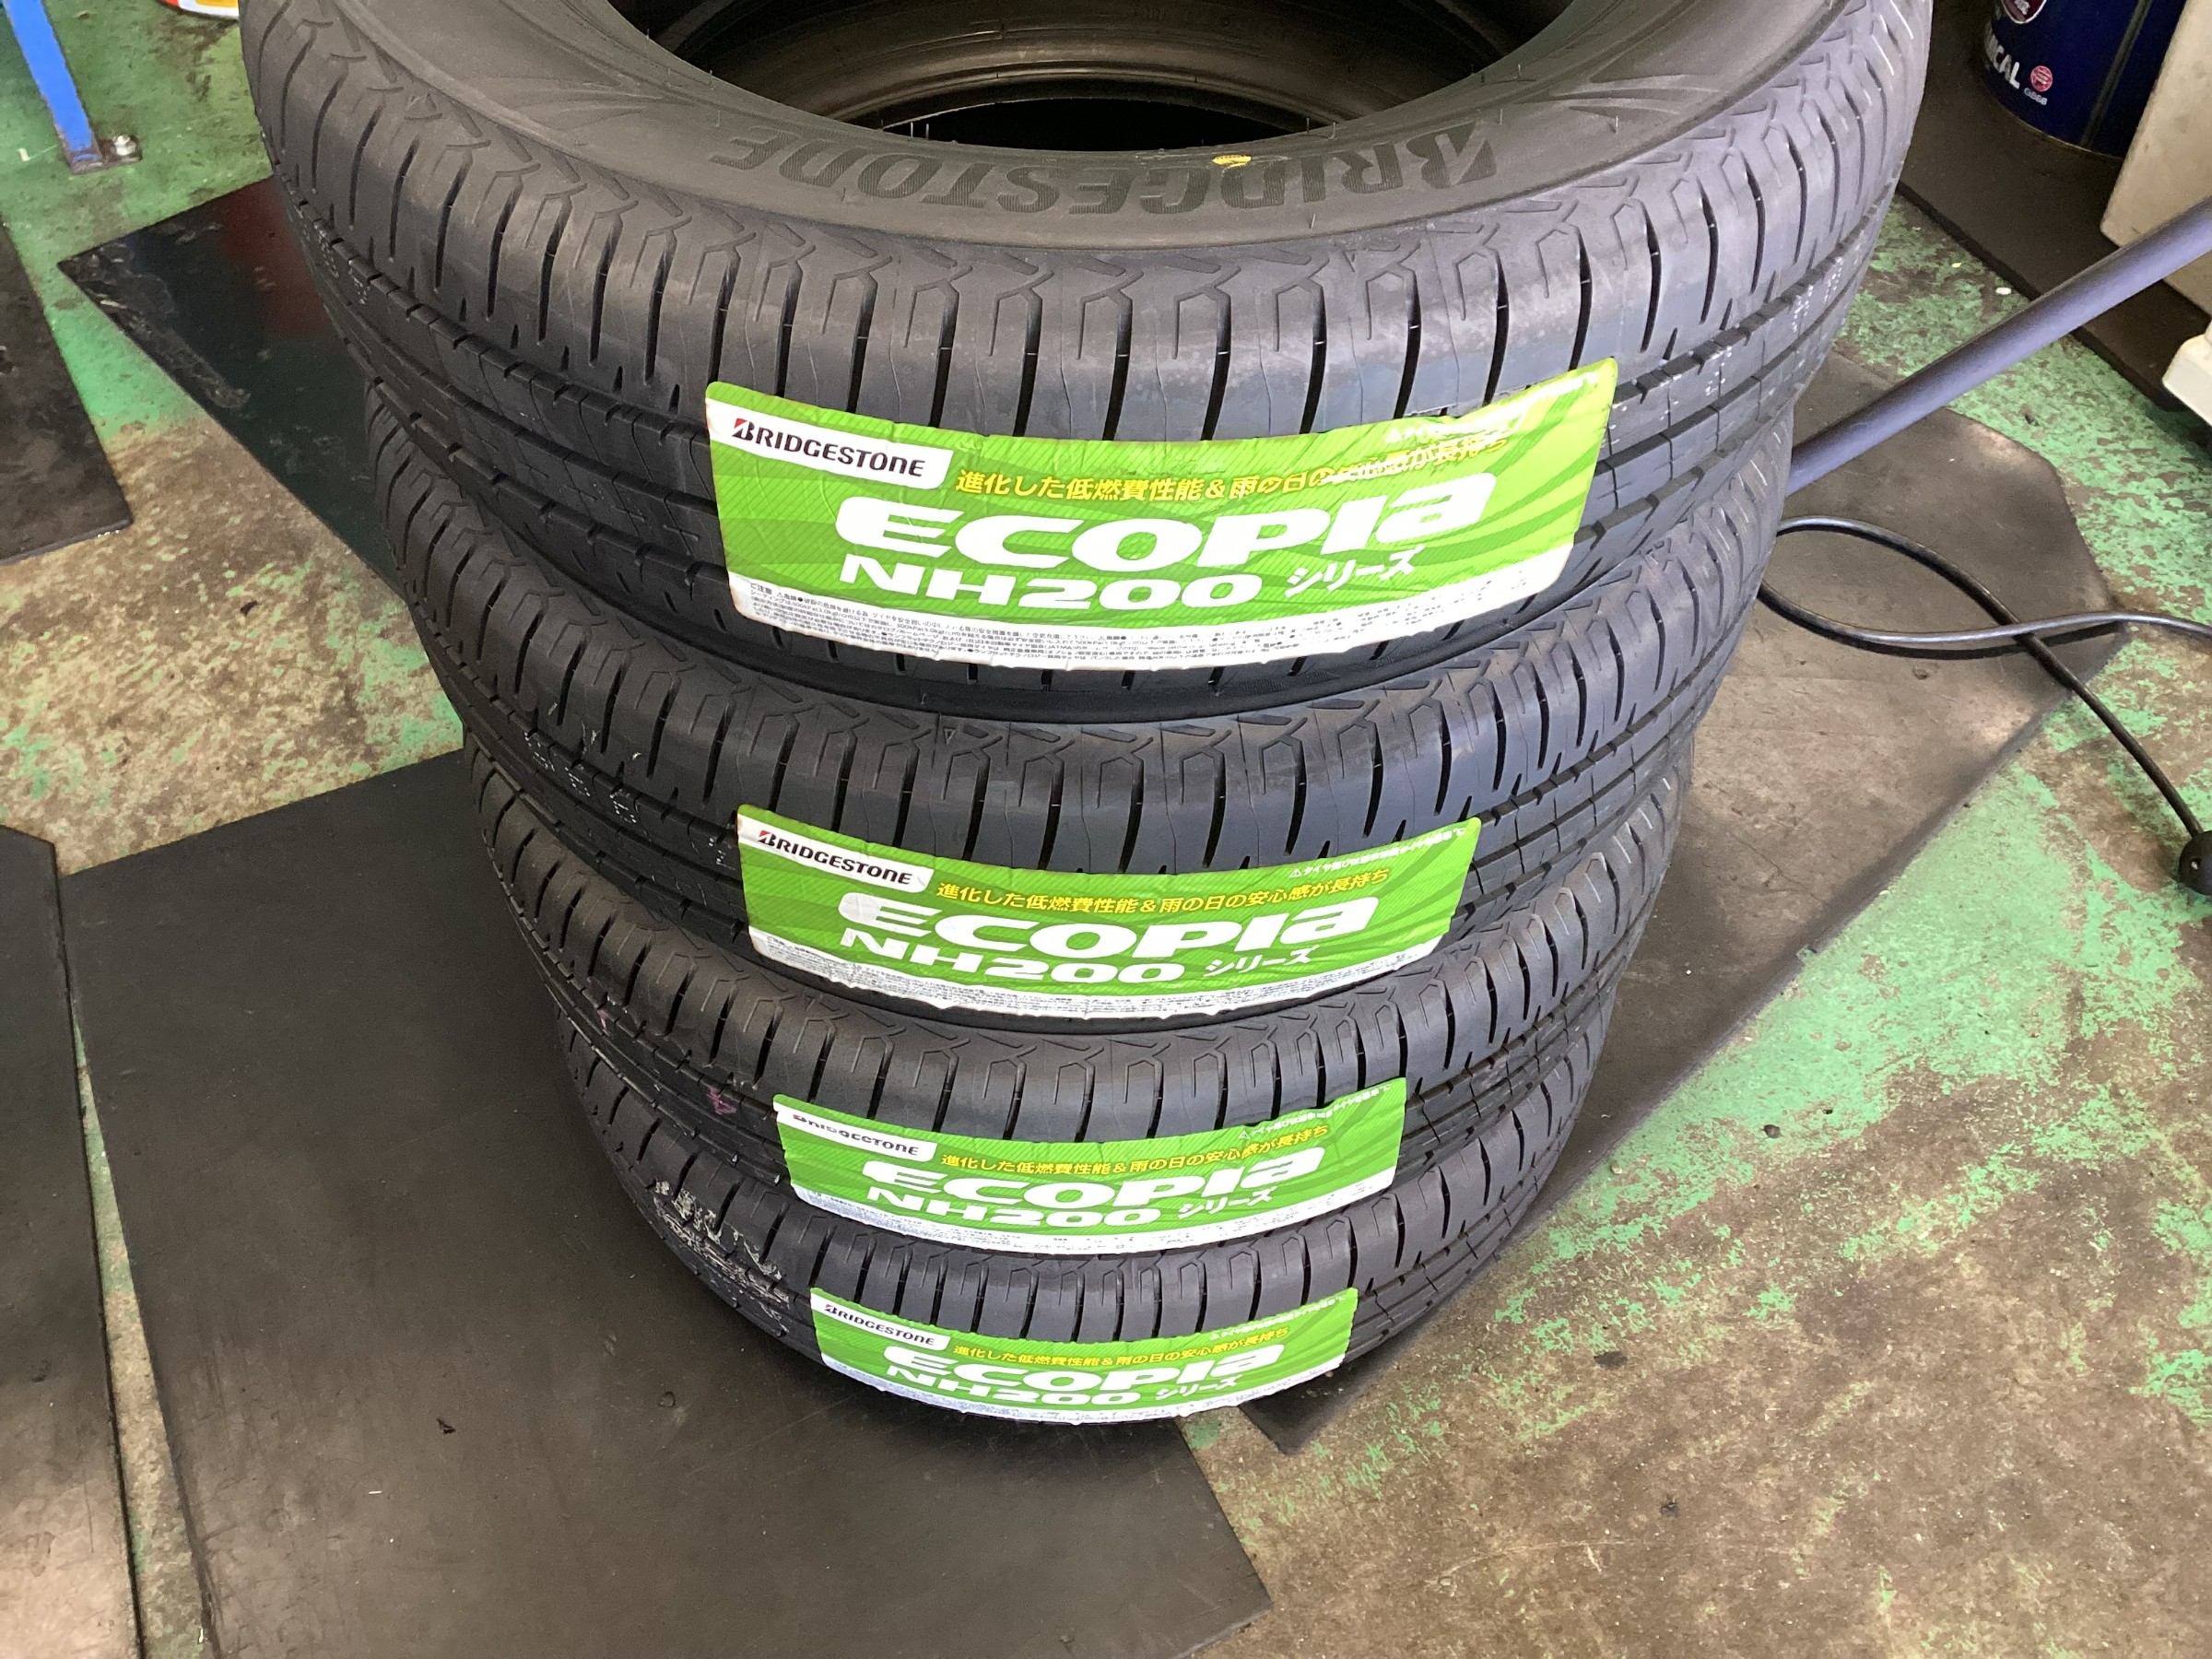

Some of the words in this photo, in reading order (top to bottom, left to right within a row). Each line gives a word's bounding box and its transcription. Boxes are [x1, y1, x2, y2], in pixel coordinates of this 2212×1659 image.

[708, 120, 1498, 215] BRIDGESTONE
[731, 418, 926, 477] BRIDGESTONE
[839, 554, 1263, 610] NH200
[1284, 544, 1425, 599] シリーズ
[759, 830, 912, 886] BRIDGESTONE
[840, 927, 1185, 983] NH200
[1203, 944, 1321, 977] シリーズ
[866, 1186, 1161, 1228] NH200
[1178, 1186, 1278, 1219] シリーズ
[825, 1303, 935, 1347] BRIDGESTONE
[886, 1365, 1141, 1406] NH200
[1155, 1374, 1243, 1401] シリーズ
